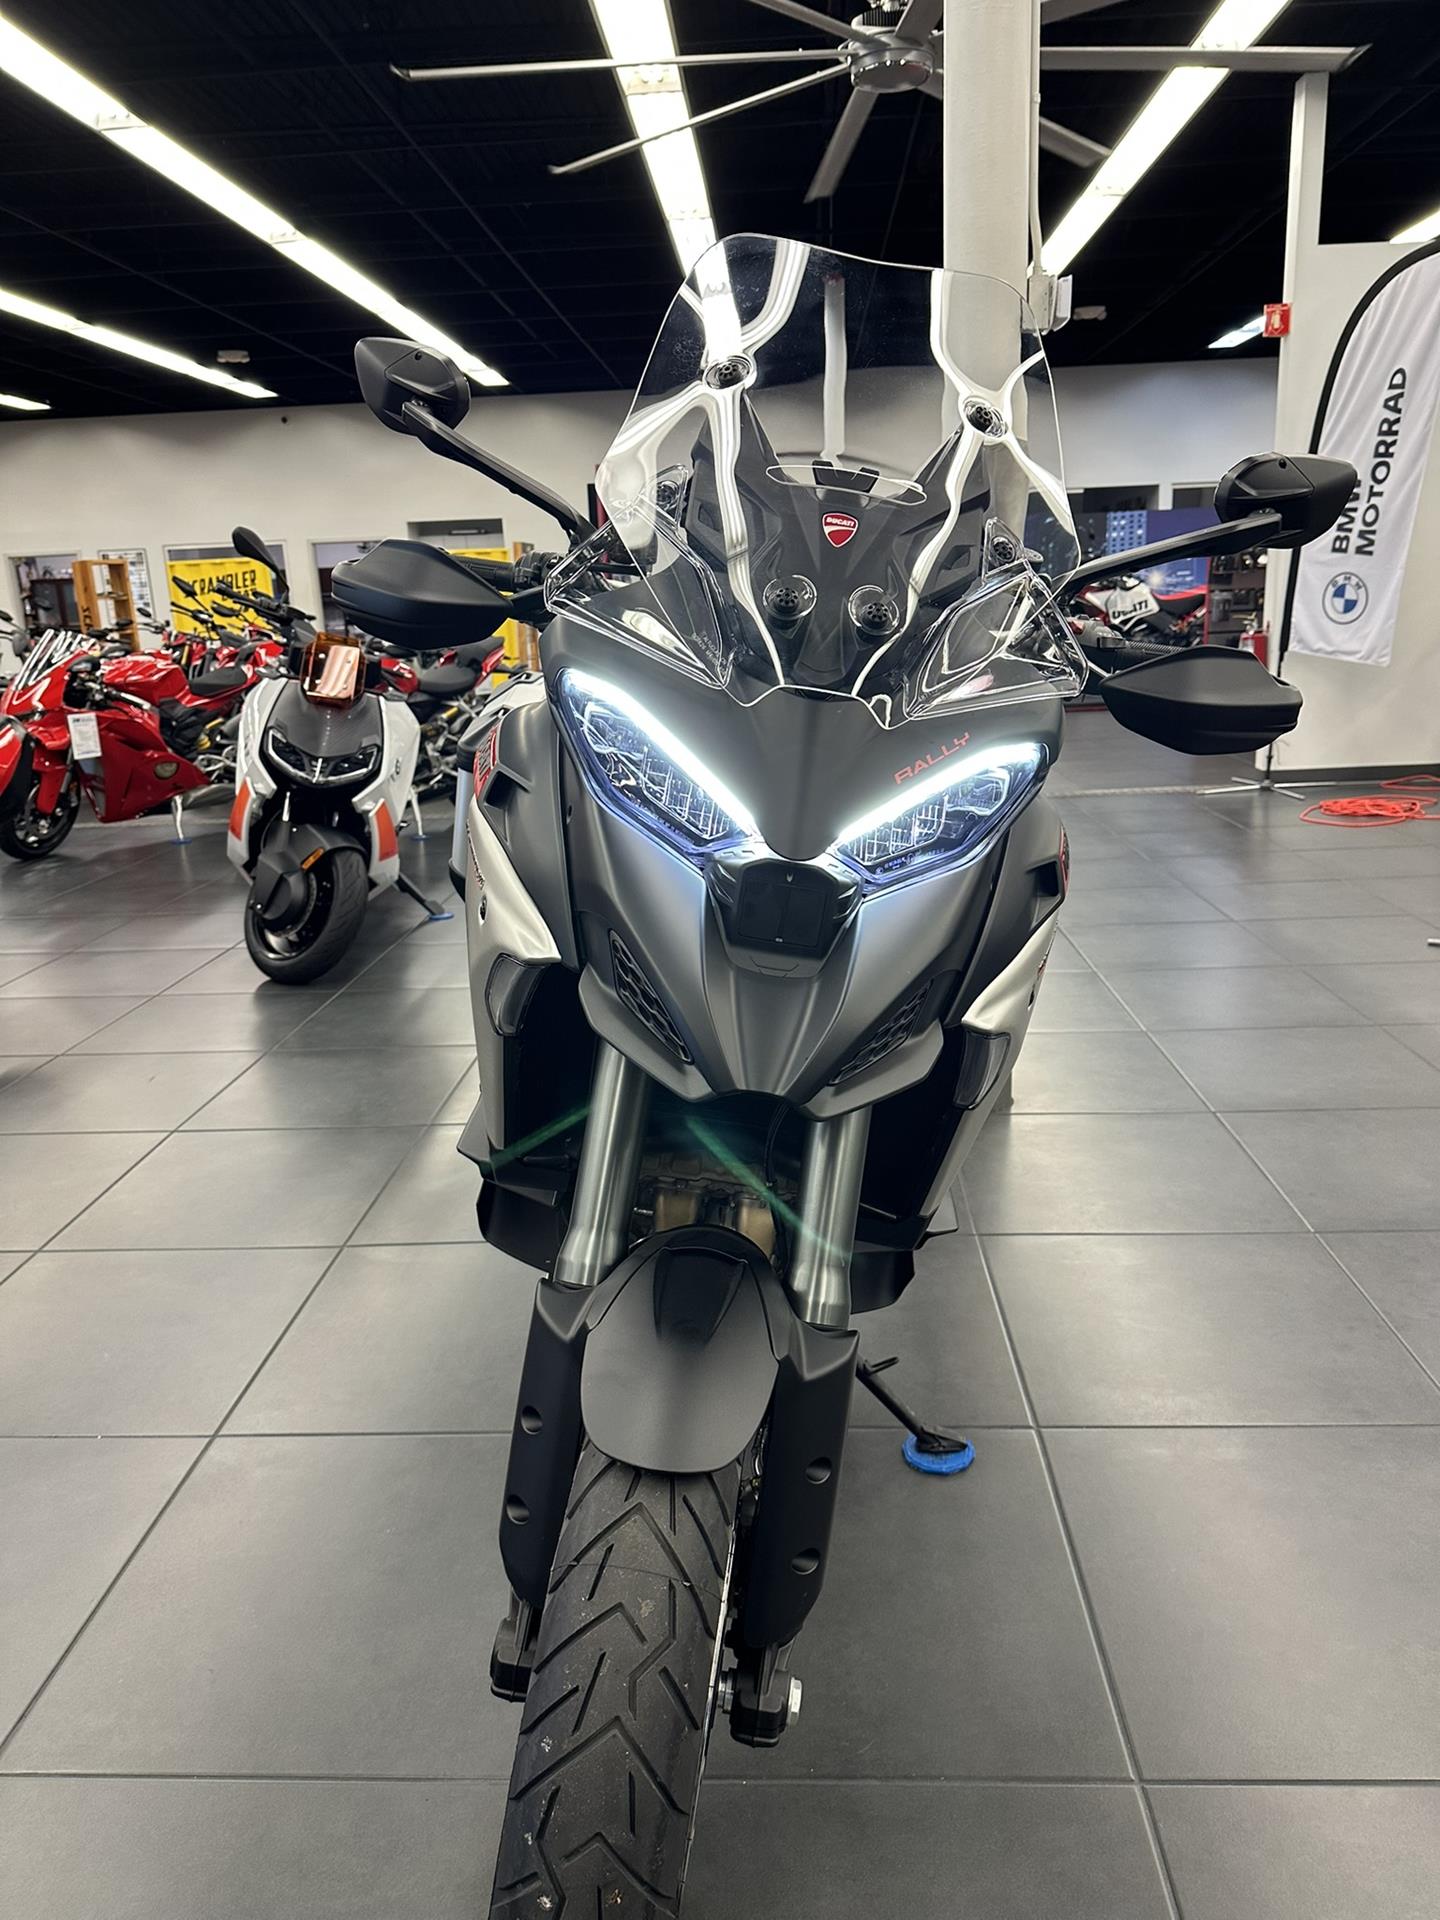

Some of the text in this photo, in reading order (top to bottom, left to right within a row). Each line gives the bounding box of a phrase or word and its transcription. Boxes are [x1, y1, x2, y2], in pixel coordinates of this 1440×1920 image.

[1355, 367, 1407, 557] MOTORRAD
[826, 516, 855, 527] DUCATI
[190, 569, 257, 596] CRABLER
[894, 731, 970, 785] RALLY
